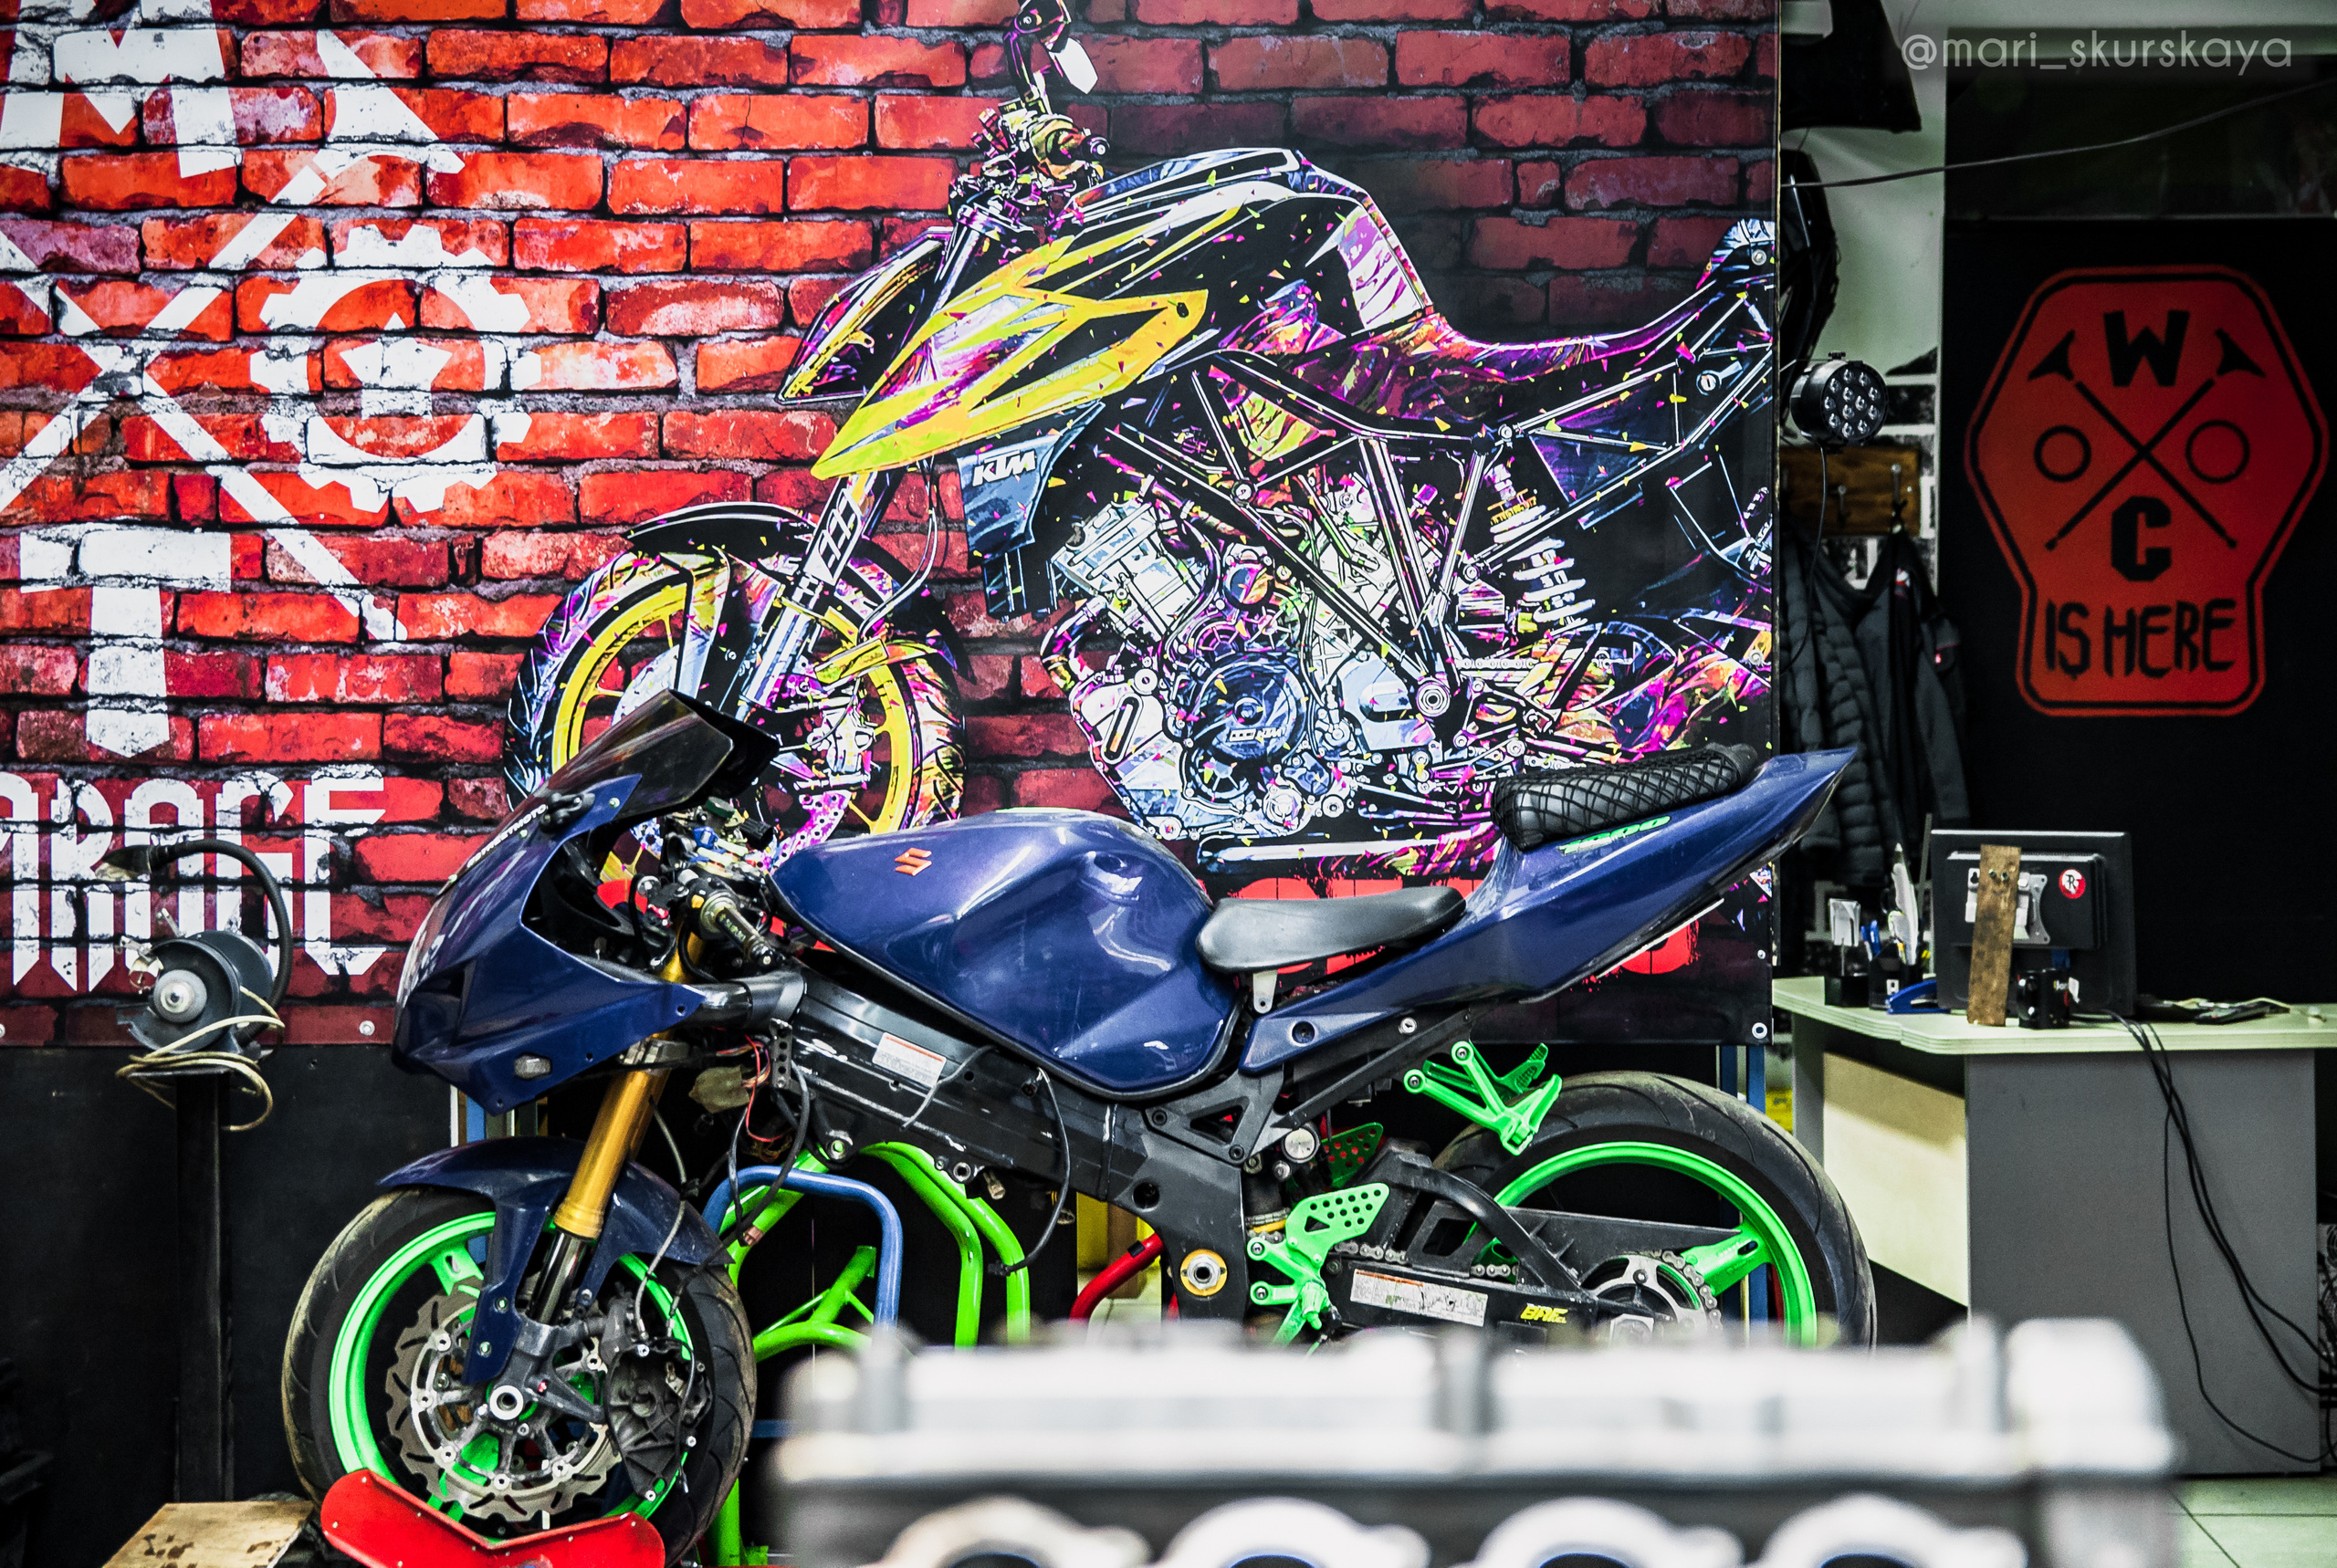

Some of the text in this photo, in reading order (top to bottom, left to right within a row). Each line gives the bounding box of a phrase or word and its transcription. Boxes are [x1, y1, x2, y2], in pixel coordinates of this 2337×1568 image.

[2103, 308, 2191, 388] W
[972, 450, 1036, 487] KTM
[2111, 496, 2173, 582] C
[2044, 598, 2237, 681] IS HERE
